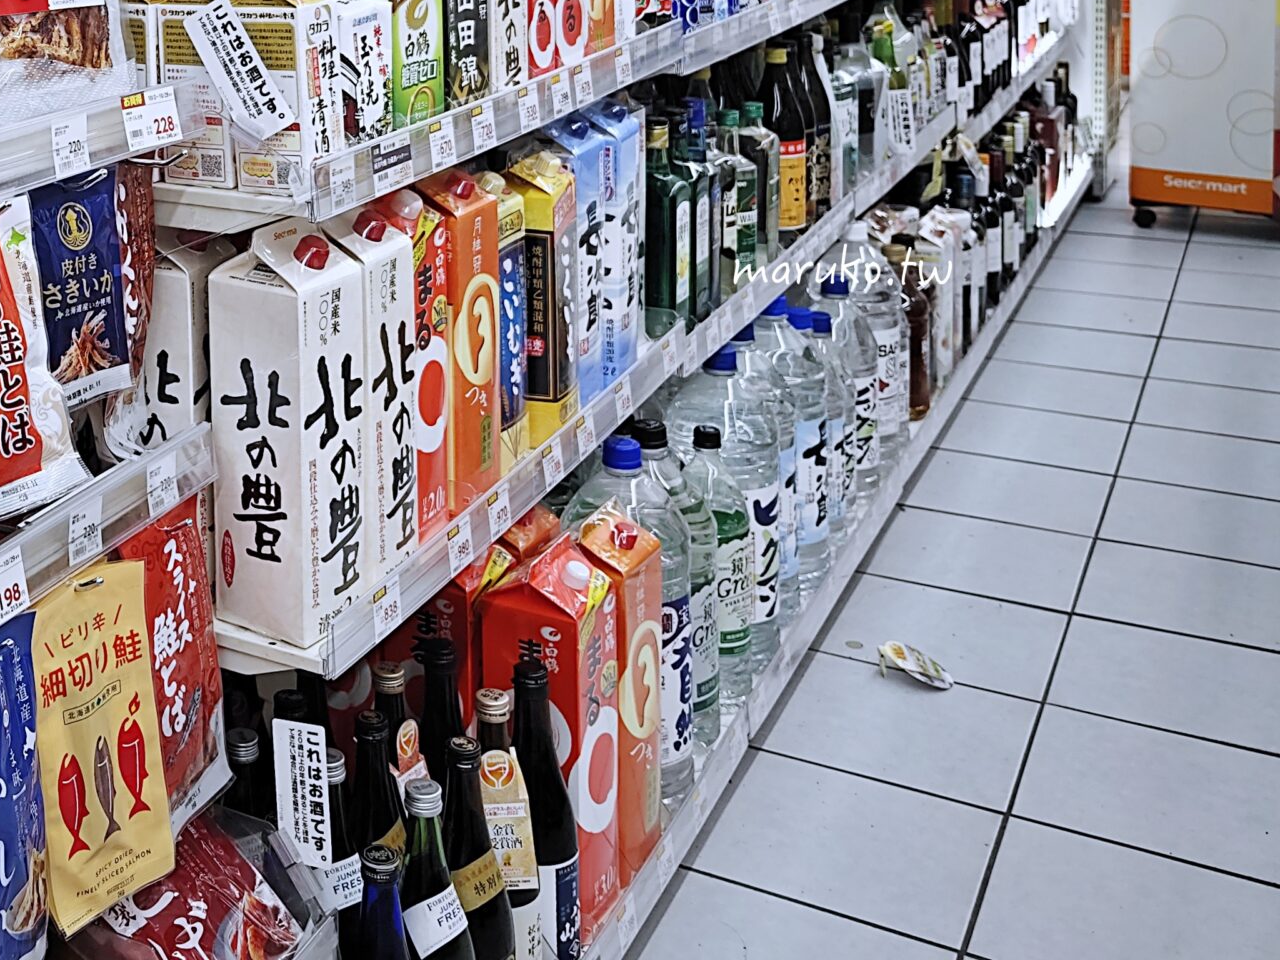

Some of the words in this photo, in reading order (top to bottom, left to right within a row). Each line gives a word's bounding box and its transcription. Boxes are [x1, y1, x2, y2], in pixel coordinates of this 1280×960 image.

[211, 3, 287, 121] これはお酒です。
[400, 59, 438, 90] 糖質ゼロ
[153, 116, 175, 135] 228
[439, 144, 453, 156] 670
[42, 269, 114, 309] さきいか
[60, 255, 98, 279] 皮付き
[330, 287, 342, 337] 国産米
[220, 356, 293, 564] 北の豊
[303, 352, 365, 597] 北の豊
[164, 538, 194, 655] スライス
[382, 598, 399, 621] 838
[60, 611, 107, 649] ピリ辛
[40, 628, 144, 709] 細切り鮭
[153, 611, 188, 738] 鮭とば
[306, 730, 328, 862] これはお酒です。
[492, 823, 516, 837] 金賞
[76, 885, 100, 899] FINELY
[100, 868, 125, 886] SLICED
[125, 847, 152, 870] SALMON
[95, 861, 113, 879] SPICY
[113, 847, 135, 865] DRIED
